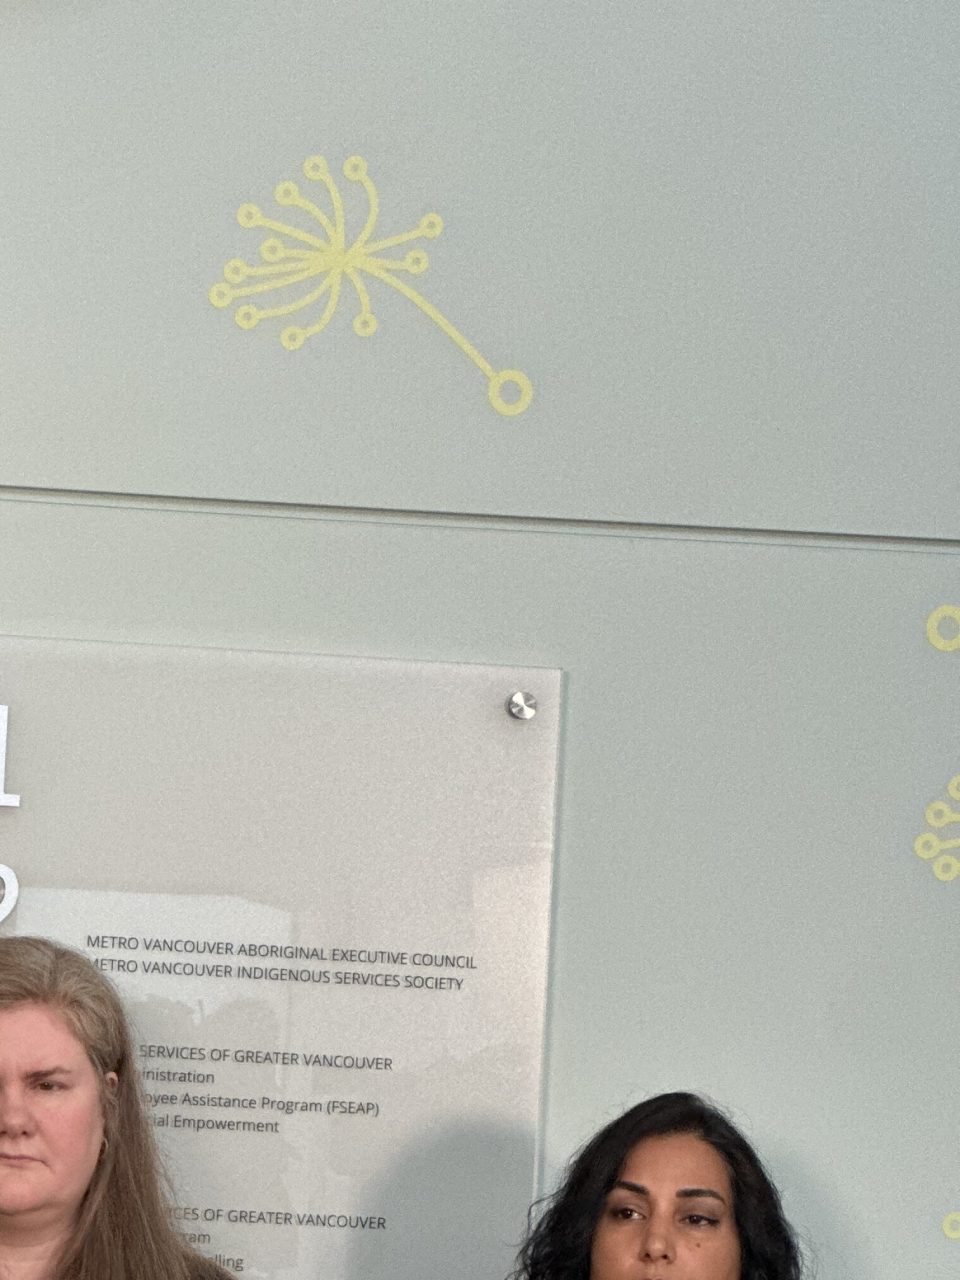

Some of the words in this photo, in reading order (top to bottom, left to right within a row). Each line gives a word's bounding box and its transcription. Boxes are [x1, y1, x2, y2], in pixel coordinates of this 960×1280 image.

[87, 935, 139, 950] METRO
[143, 938, 234, 955] VANCOUVER
[237, 943, 327, 961] ABORIGINAL
[332, 948, 408, 965] EXECUTIVE
[412, 953, 477, 969] COUNCIL
[142, 961, 232, 978] VANCOUVER
[237, 966, 330, 984] INDIGENOUS
[334, 971, 401, 988] SERVICES
[404, 975, 464, 990] SOCIETY
[140, 1045, 206, 1060] SERVICES
[210, 1048, 230, 1062] OF
[235, 1050, 300, 1065] GREATER
[303, 1053, 393, 1070] VANCOUVER
[182, 1092, 257, 1109] Assistance
[261, 1097, 323, 1114] Program
[327, 1100, 379, 1117] (FSEAP)
[173, 1115, 280, 1133] Empowerment
[203, 1208, 225, 1221] OF
[228, 1210, 293, 1225] GREATER
[297, 1213, 386, 1230] VANCOUVER
